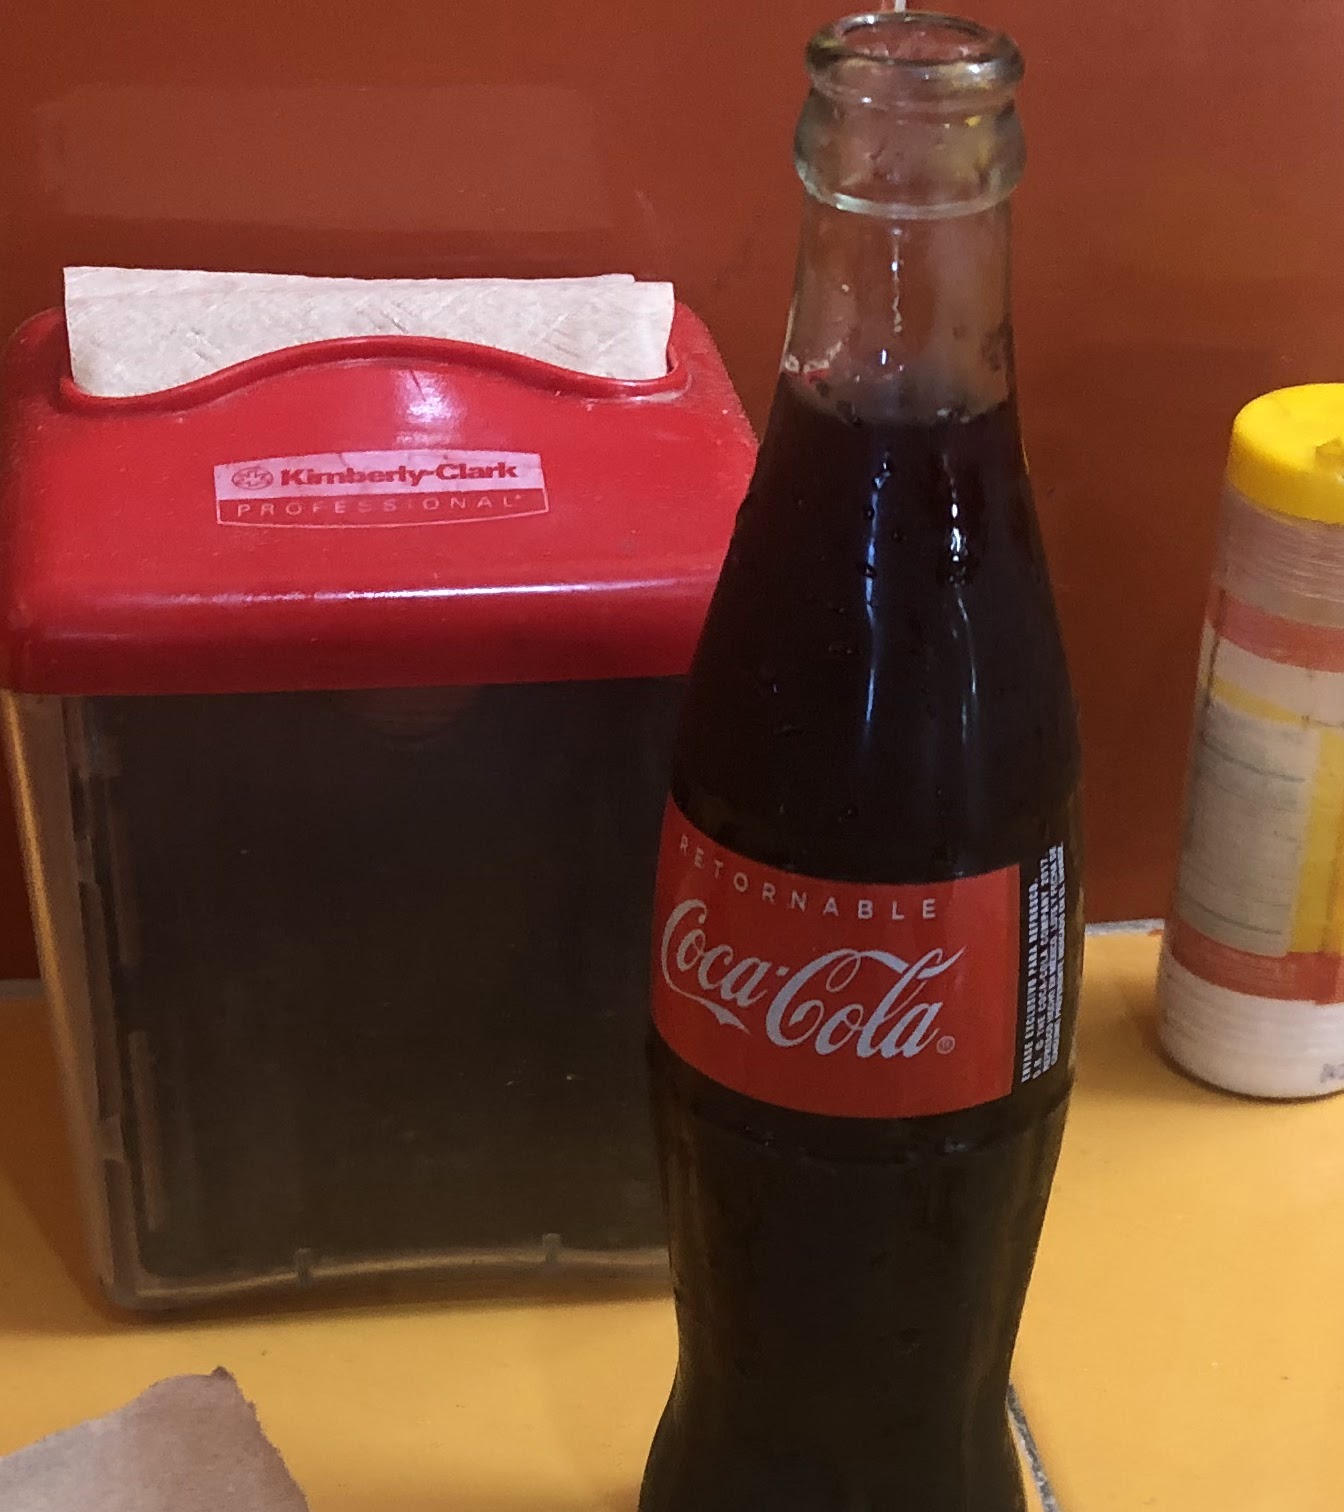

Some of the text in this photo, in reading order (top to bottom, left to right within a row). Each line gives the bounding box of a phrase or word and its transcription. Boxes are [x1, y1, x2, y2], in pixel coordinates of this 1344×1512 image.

[280, 462, 519, 487] Kimberly-Clark
[237, 495, 514, 517] PROFESSIONAL
[678, 834, 937, 920] RETORNABLE
[660, 899, 967, 1059] Coca-Cola
[1027, 944, 1038, 977] PARA
[1037, 948, 1049, 1013] COCA-COLA
[1024, 978, 1037, 1039] EXCLUSIVO
[1020, 1040, 1034, 1083] ENVASE
